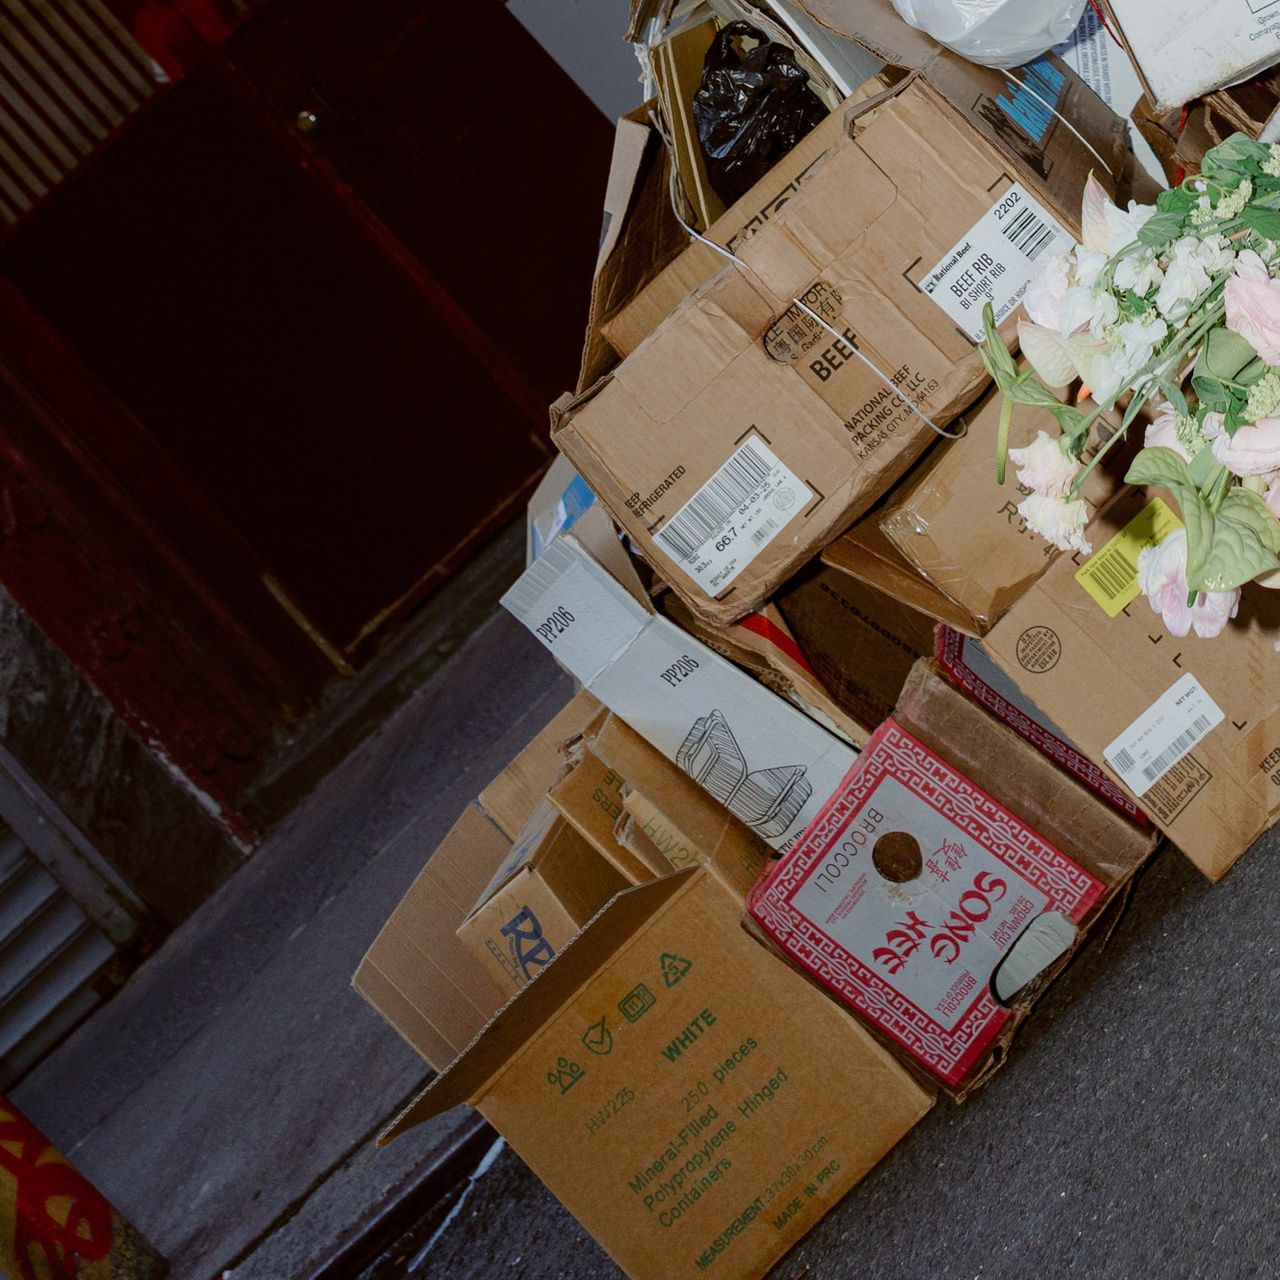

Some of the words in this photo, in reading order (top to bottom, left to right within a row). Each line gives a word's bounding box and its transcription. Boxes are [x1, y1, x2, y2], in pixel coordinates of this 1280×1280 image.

[1258, 11, 1279, 26] Grown
[933, 256, 958, 282] National
[956, 243, 971, 258] Beef
[994, 192, 1021, 219] 2202
[950, 270, 975, 297] BEEF
[972, 254, 993, 275] RIB
[960, 298, 972, 309] BI
[968, 276, 992, 301] SHORT
[990, 263, 1005, 279] RIB
[991, 305, 1010, 323] CHOICE
[810, 328, 858, 382] BEEF
[845, 388, 892, 432] NATIONAL
[888, 365, 910, 390] BEEF
[852, 406, 892, 447] PACKING
[906, 373, 925, 391] LLC
[858, 428, 888, 459] KANSAS
[887, 414, 906, 432] CITY,
[917, 379, 938, 402] 64163
[739, 480, 770, 514] 04-03-25
[716, 527, 737, 551] 66.7
[536, 606, 575, 644] PP206
[660, 654, 700, 688] PP206
[812, 807, 884, 894] BROCCOLI
[873, 911, 931, 974] HEE
[931, 872, 1006, 963] SONG
[943, 975, 979, 1019] BROCCOLI
[660, 1008, 717, 1065] WHITE
[679, 1082, 712, 1112] 250
[711, 1035, 759, 1084] pieces
[584, 1087, 636, 1135] HW225
[628, 1105, 718, 1194] Mineral-Filled
[642, 1120, 737, 1215] Polypropylene
[737, 1068, 790, 1119] Hinged
[658, 1157, 733, 1229] Containers
[772, 1195, 806, 1232] MADE
[815, 1161, 841, 1188] PRC
